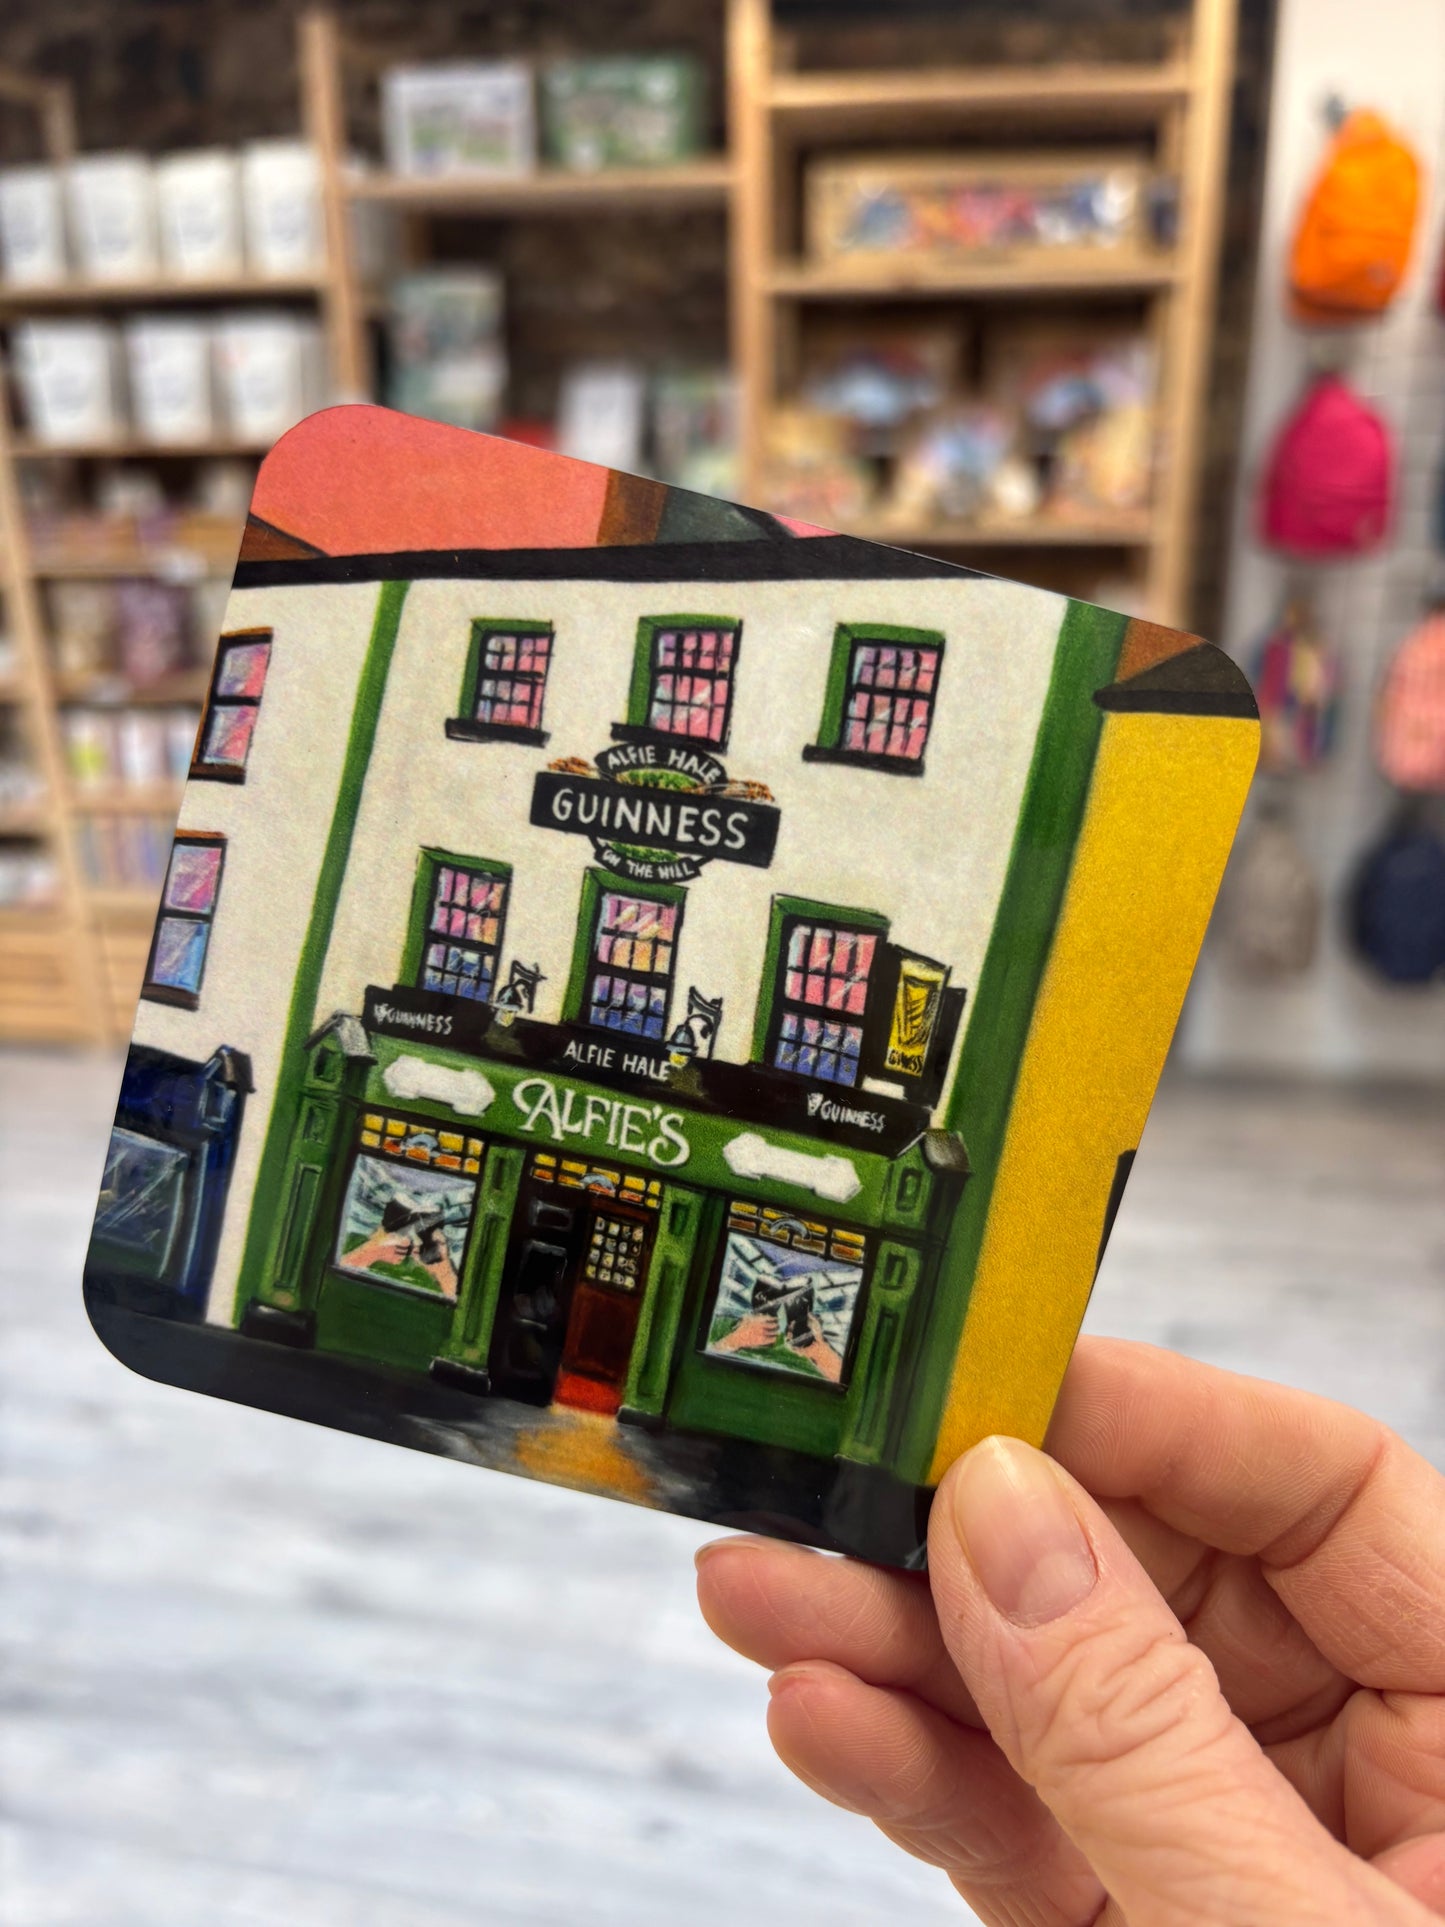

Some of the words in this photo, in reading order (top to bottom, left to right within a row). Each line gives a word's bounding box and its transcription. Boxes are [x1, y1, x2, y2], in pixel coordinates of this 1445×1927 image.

[606, 745, 656, 769] ALFIE
[667, 749, 722, 784] HALE
[552, 788, 749, 850] GUINNESS
[626, 859, 654, 878] THE
[563, 1039, 614, 1069] ALFIE
[622, 1053, 671, 1082] HALE
[512, 1077, 691, 1167] ALFIE'S
